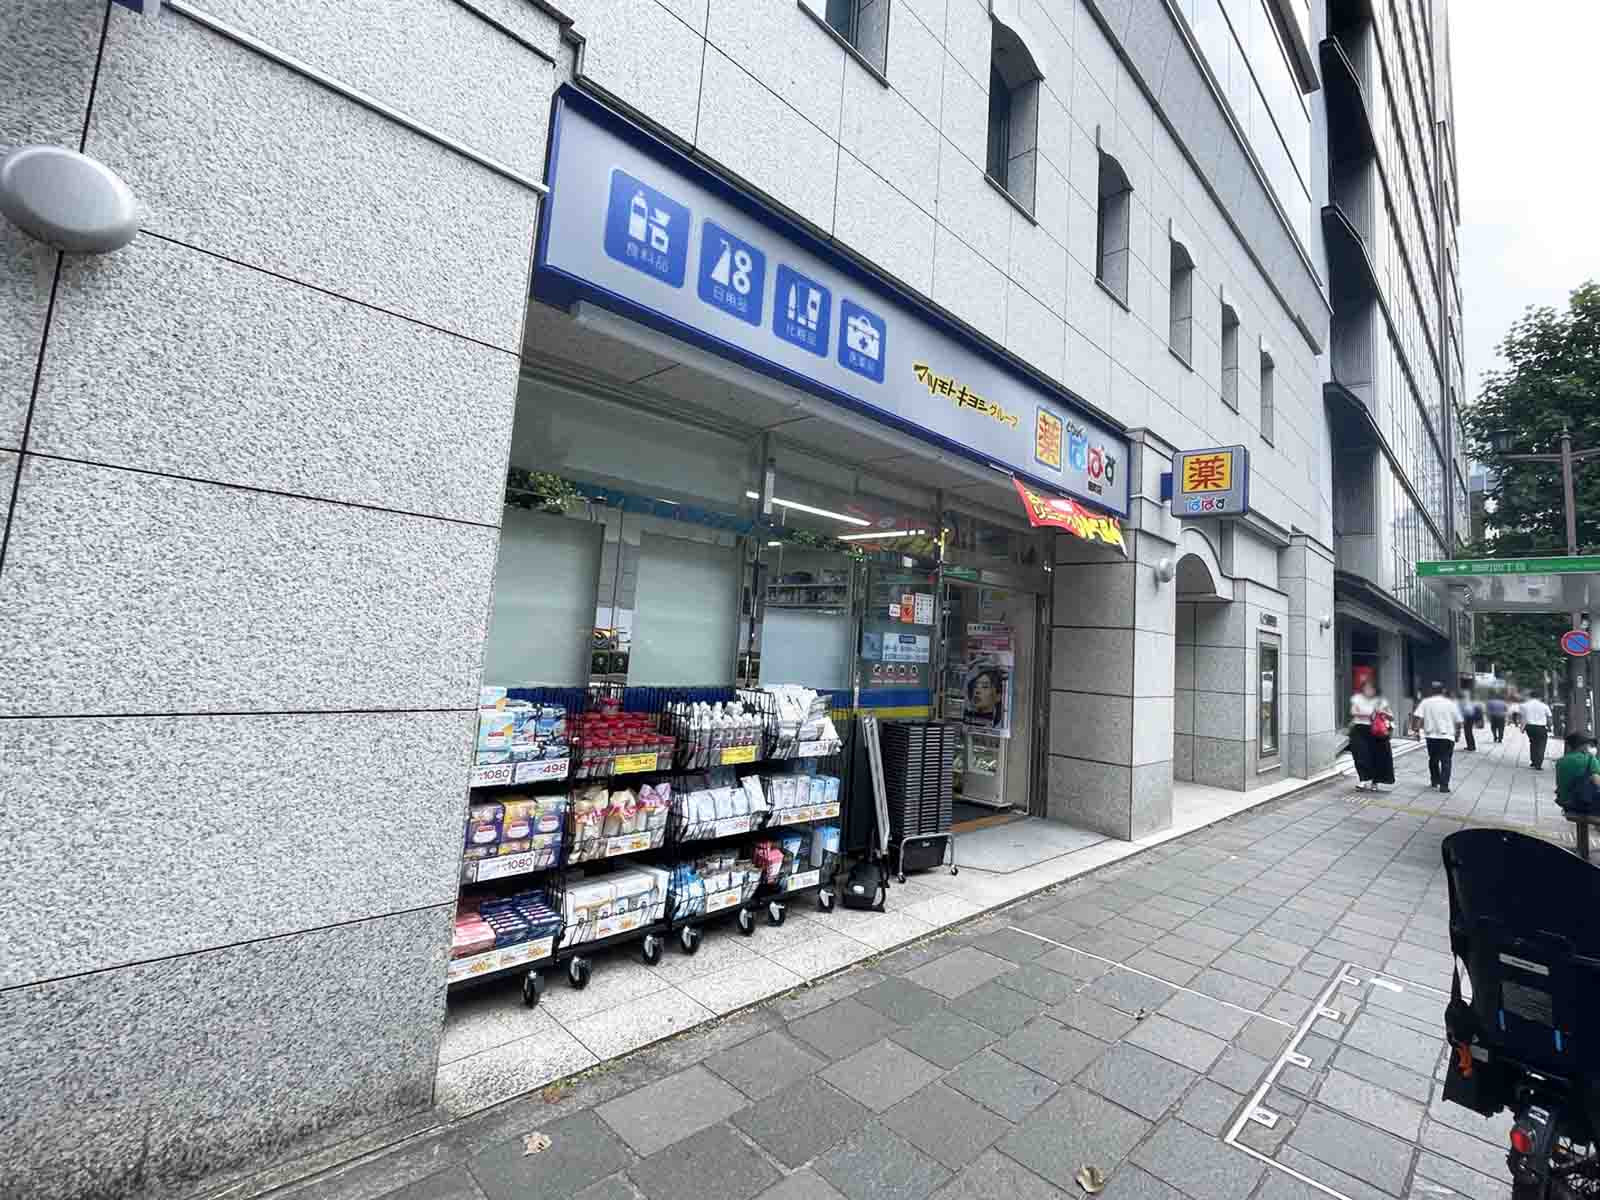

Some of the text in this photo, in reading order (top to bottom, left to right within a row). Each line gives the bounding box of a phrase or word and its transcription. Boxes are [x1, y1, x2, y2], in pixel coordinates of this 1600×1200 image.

[1039, 412, 1060, 464] 薬
[1189, 455, 1225, 490] 薬
[483, 768, 510, 780] 1080
[544, 763, 567, 773] 498
